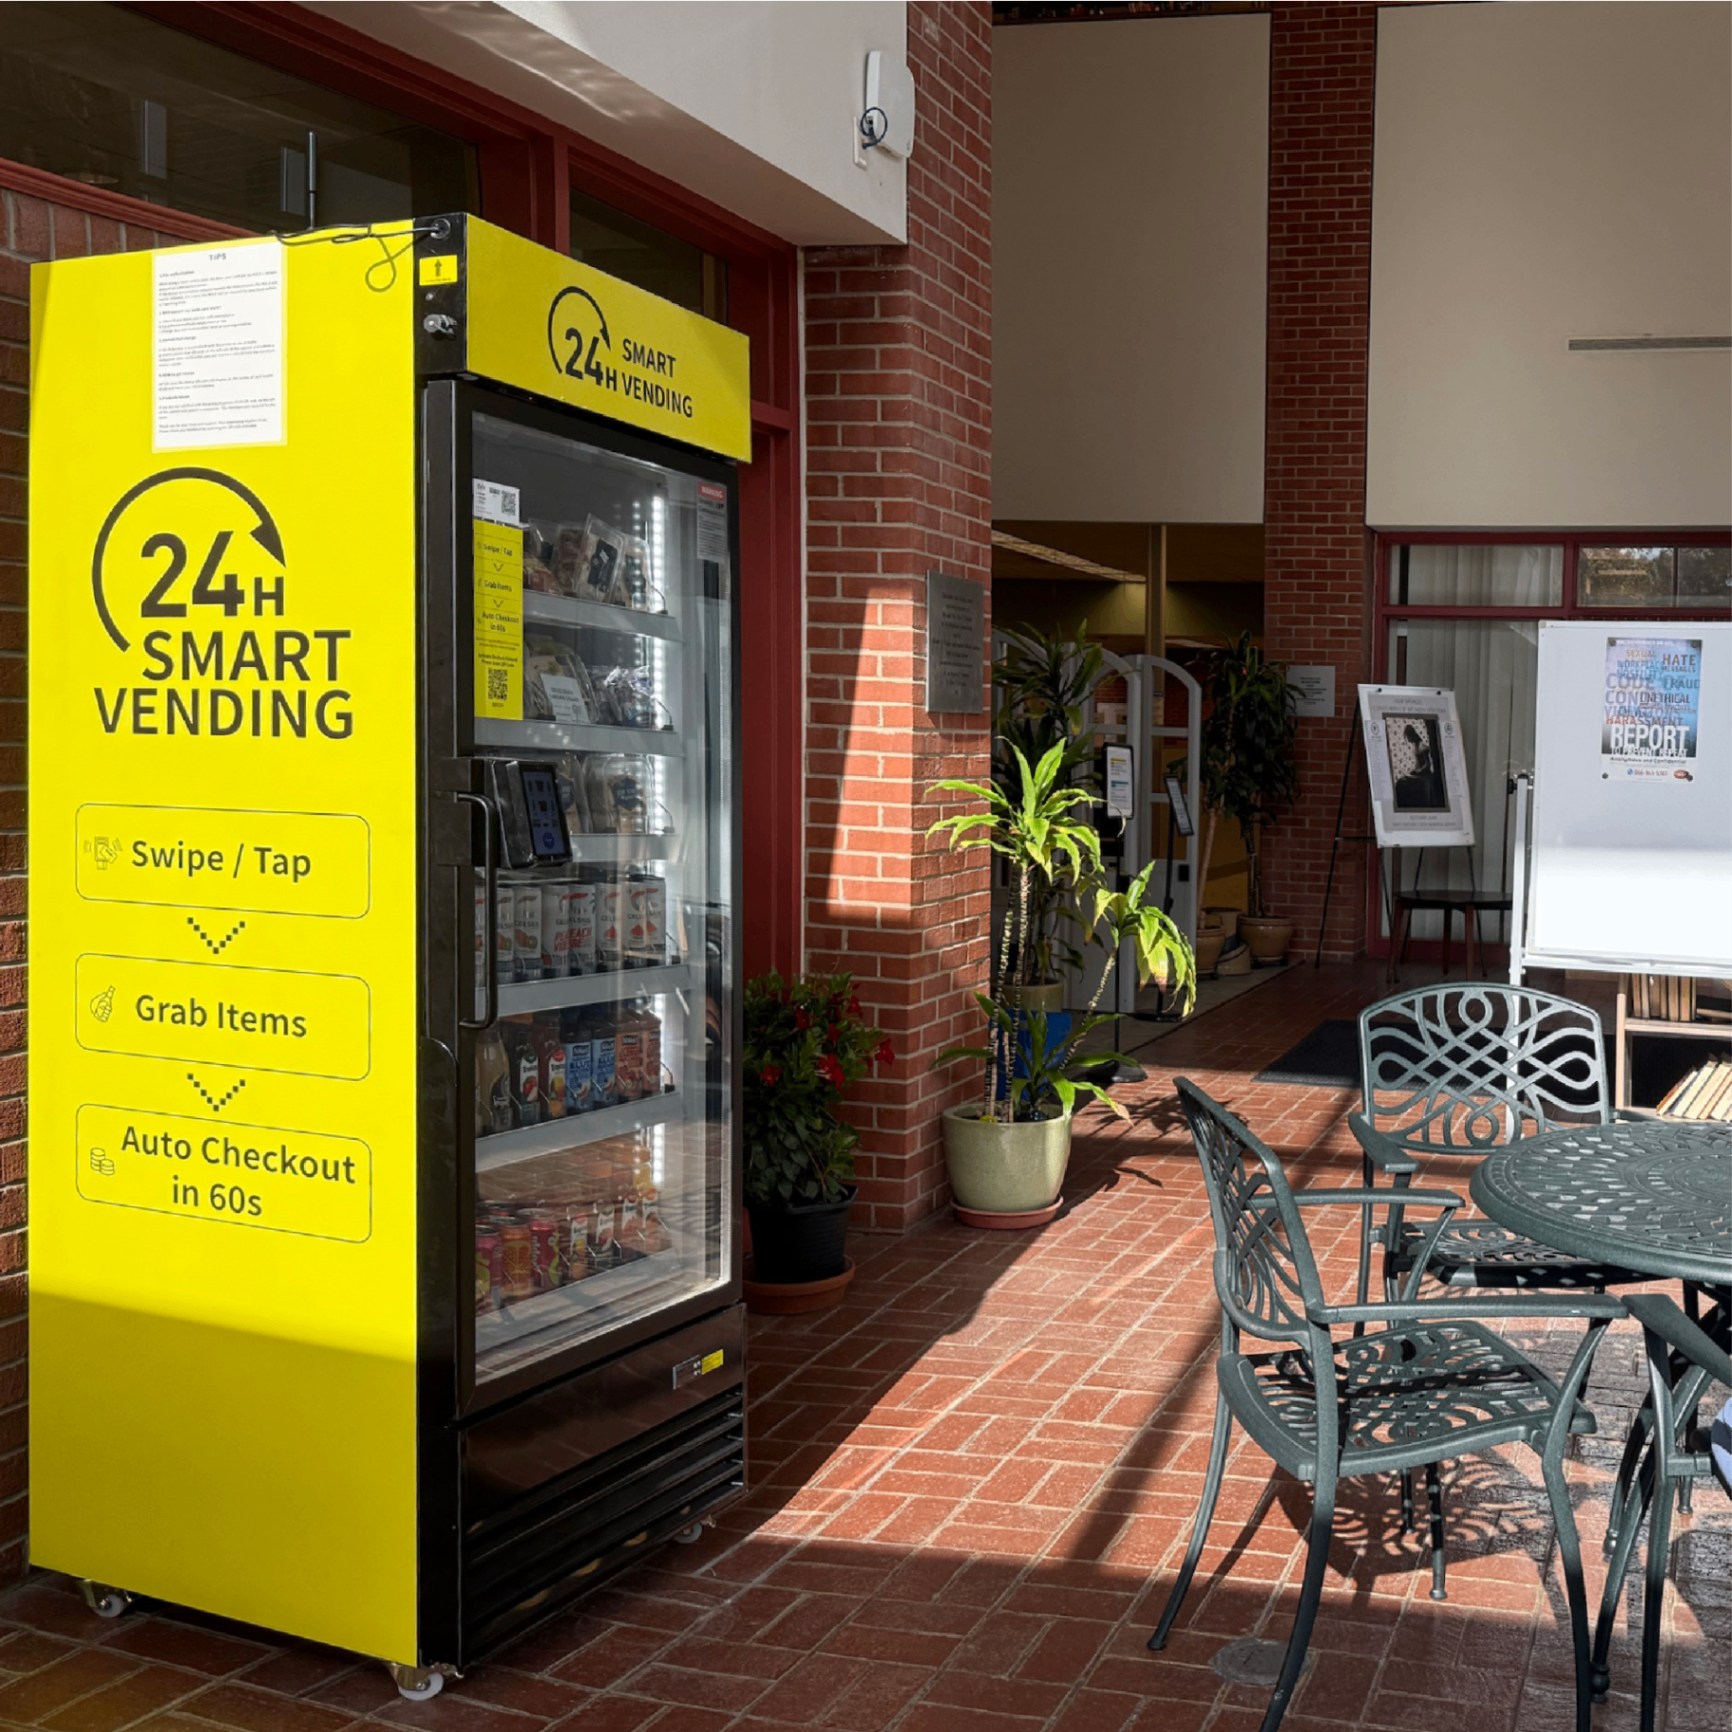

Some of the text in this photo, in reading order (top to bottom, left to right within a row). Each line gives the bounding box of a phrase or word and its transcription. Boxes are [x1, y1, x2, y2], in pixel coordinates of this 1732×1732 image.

[565, 327, 618, 392] 24H
[622, 338, 676, 378] SMART
[621, 372, 693, 418] VENDING
[140, 530, 285, 618] 24H
[495, 613, 520, 623] Checkout
[142, 629, 352, 682] SMART
[1662, 653, 1697, 666] HATE
[93, 687, 353, 740] VENDING
[1610, 723, 1690, 750] REPORT
[132, 840, 311, 883] Swipe / Tap
[135, 994, 307, 1038] Grab Items
[121, 1126, 356, 1184] Auto Checkout
[172, 1174, 262, 1216] in 60s
